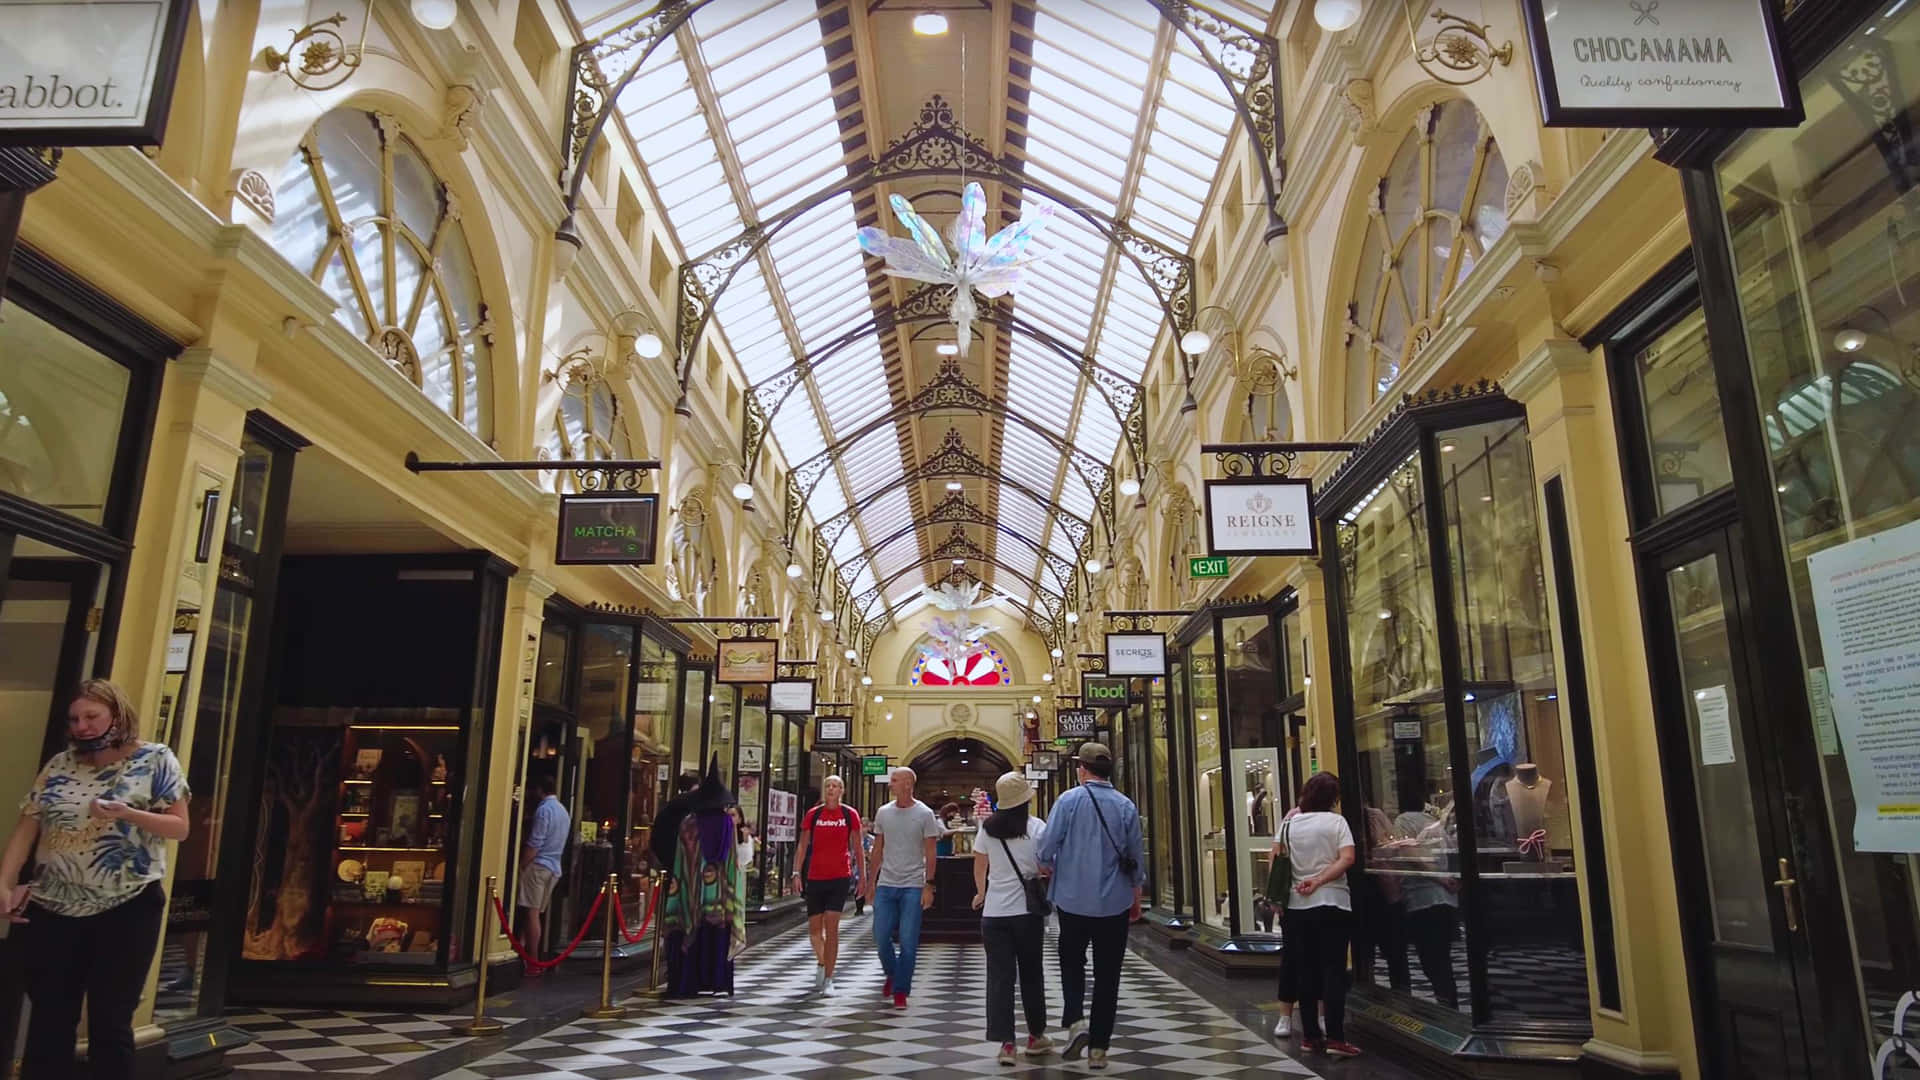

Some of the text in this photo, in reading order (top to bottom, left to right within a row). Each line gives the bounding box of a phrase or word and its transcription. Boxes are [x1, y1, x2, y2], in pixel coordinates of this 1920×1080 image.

[1573, 37, 1733, 64] CHOCAMAMA
[1580, 75, 1632, 92] Quality
[1227, 514, 1297, 528] REIGNE
[574, 526, 637, 537] MATCHA
[1198, 560, 1225, 575] EXIT
[1088, 683, 1126, 698] hoot
[1059, 714, 1094, 724] GAMES
[1063, 723, 1090, 731] SHOP
